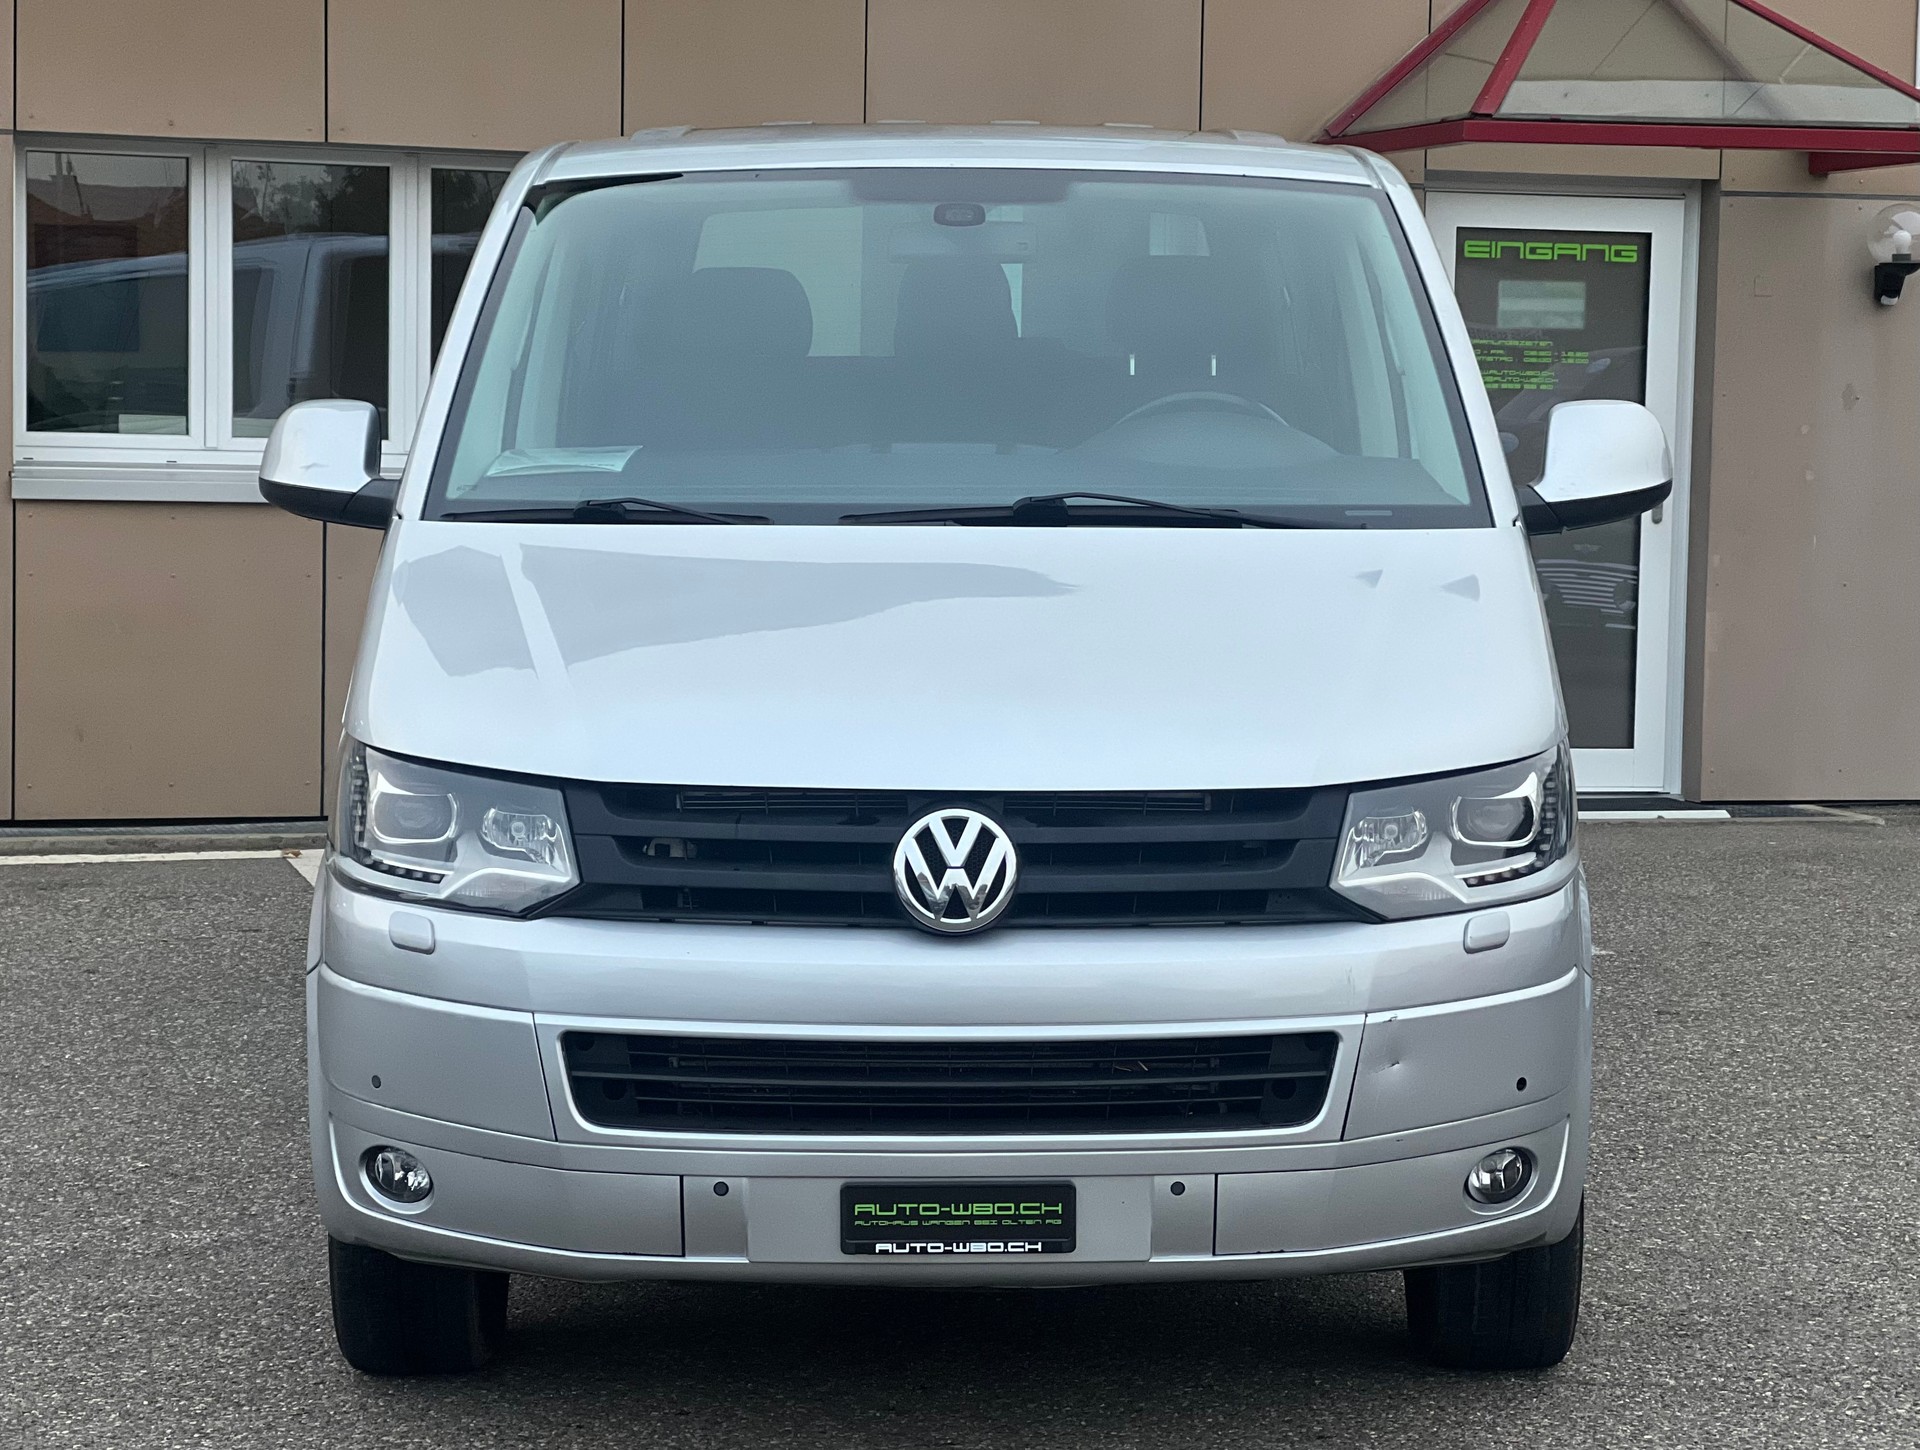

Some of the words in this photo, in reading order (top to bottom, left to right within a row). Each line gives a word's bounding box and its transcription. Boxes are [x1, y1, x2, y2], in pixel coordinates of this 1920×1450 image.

[1464, 240, 1638, 263] EINGANG
[854, 1202, 1063, 1216] AUTO-WBO.CH
[875, 1242, 1042, 1254] AUTO-WBO.CH
